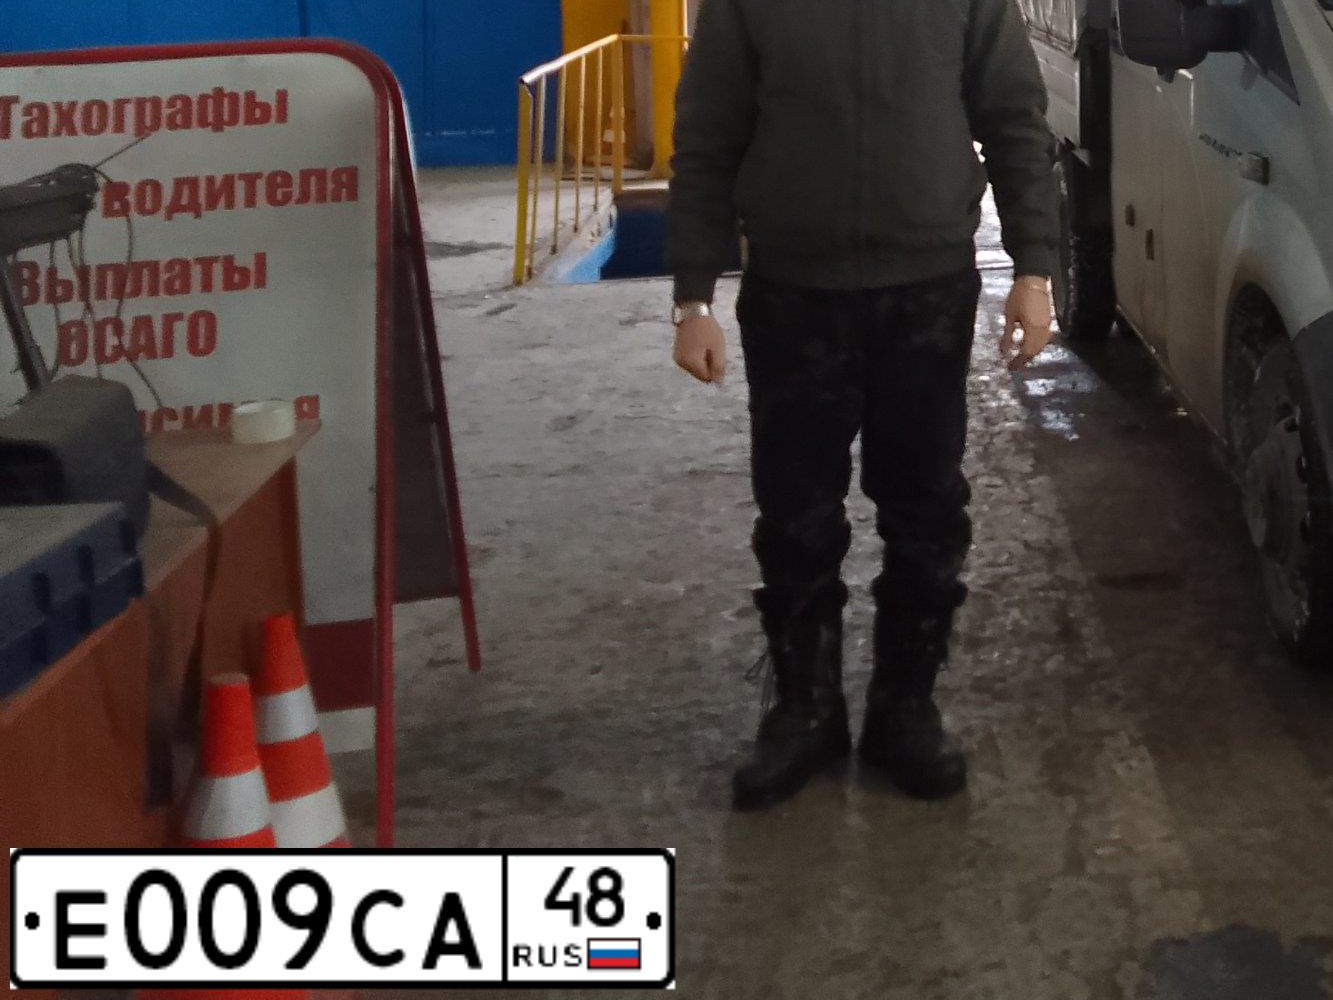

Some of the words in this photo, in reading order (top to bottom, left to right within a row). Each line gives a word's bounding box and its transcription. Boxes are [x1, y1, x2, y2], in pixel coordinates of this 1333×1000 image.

[0, 87, 288, 140] Тахографы
[101, 166, 358, 221] водителя
[14, 252, 267, 307] Выплаты
[57, 310, 218, 366] ОСАГО
